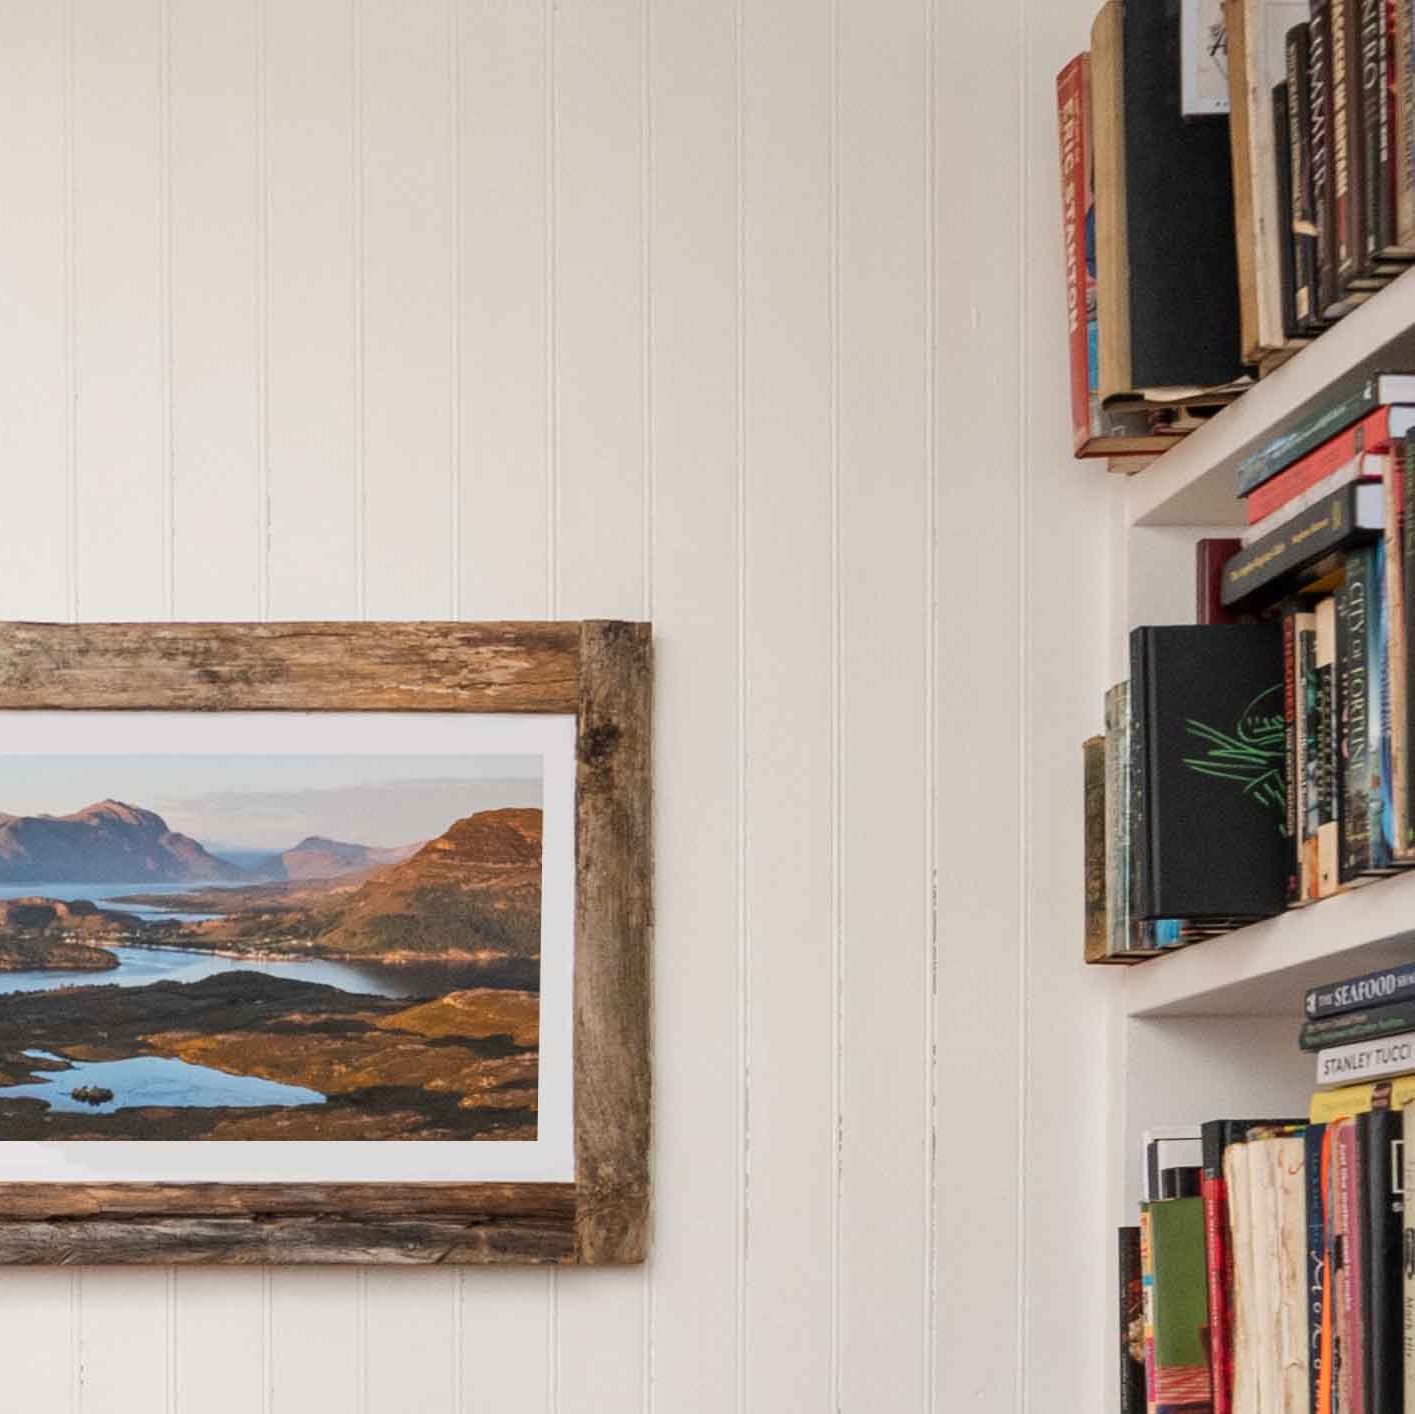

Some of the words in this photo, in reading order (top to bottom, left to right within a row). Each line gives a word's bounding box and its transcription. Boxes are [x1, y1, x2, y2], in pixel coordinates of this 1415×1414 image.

[1331, 0, 1346, 84] ASCISM
[1063, 96, 1077, 175] ERIC
[1309, 16, 1327, 197] HIMMLER
[1065, 181, 1079, 335] STANTON
[1349, 582, 1366, 632] CITY
[1350, 667, 1367, 772] FORTUNE
[1334, 973, 1397, 1008] SEAFOOD
[1323, 1051, 1372, 1076] STANLEY
[1375, 1042, 1412, 1065] TUCCI
